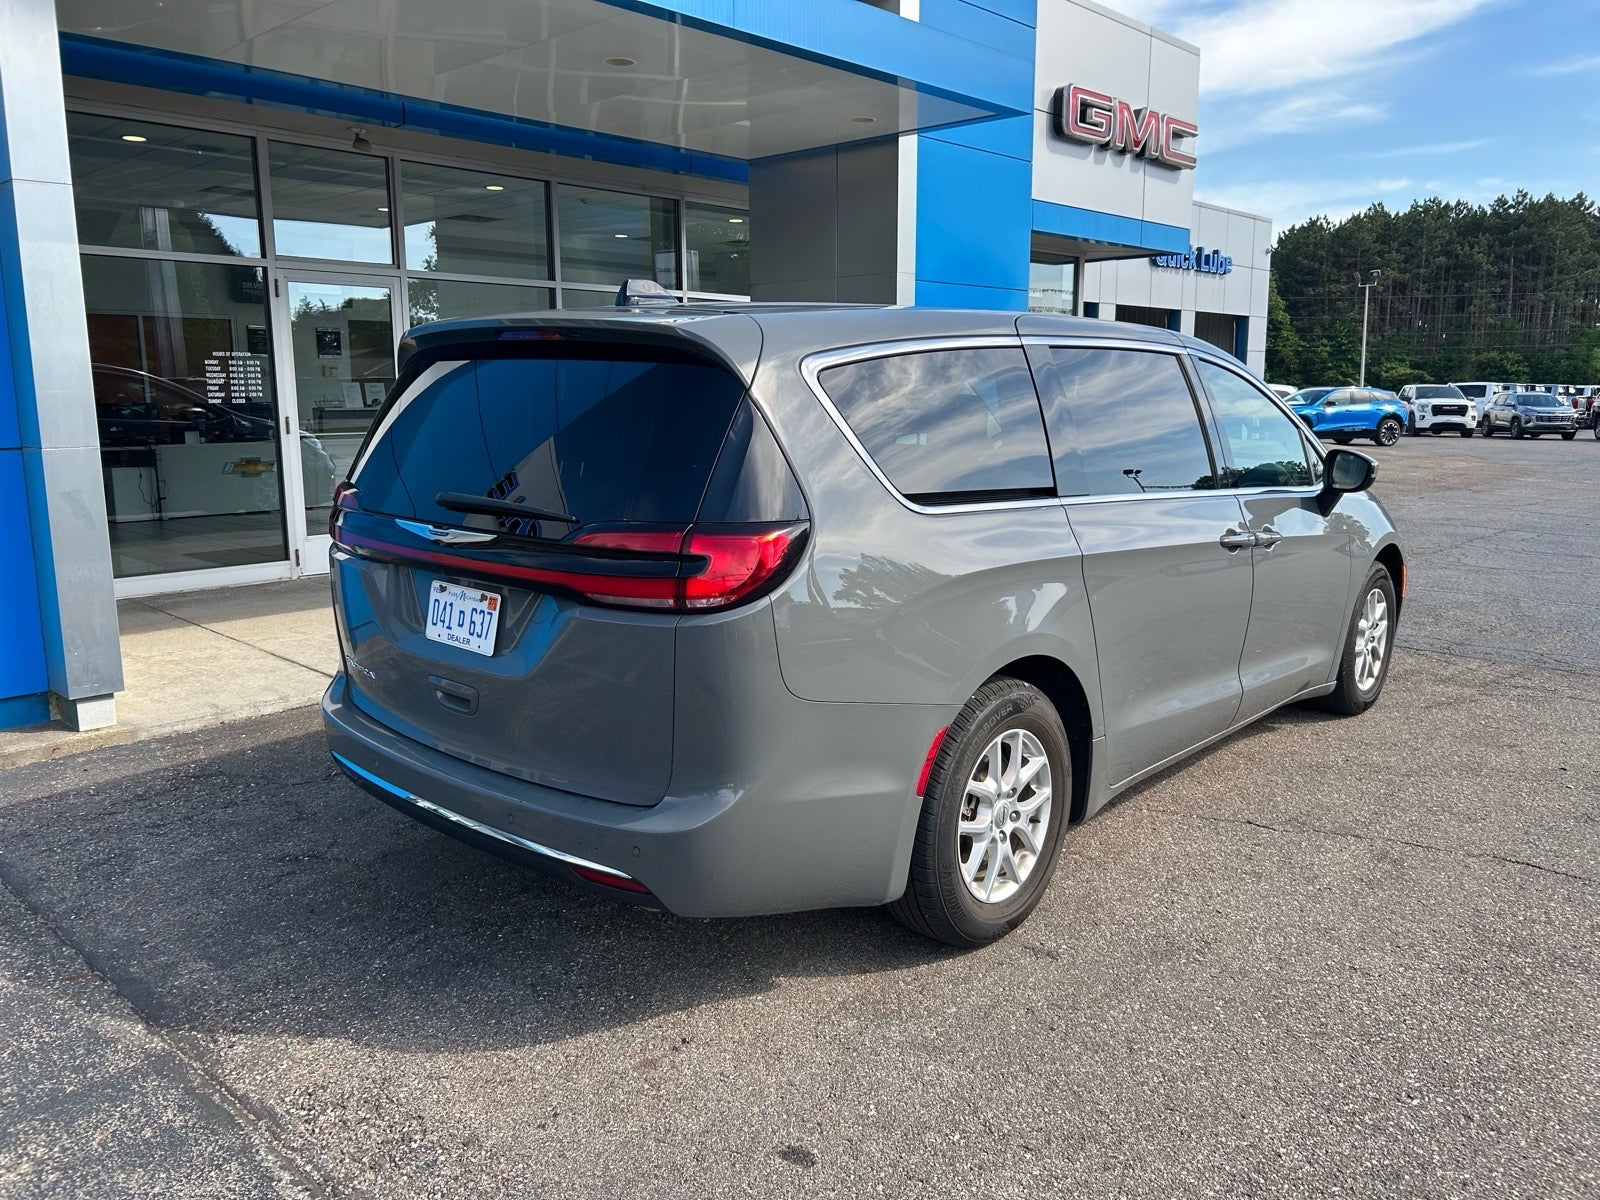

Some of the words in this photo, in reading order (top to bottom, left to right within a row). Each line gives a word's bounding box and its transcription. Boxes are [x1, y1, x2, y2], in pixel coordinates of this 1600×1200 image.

[1056, 83, 1198, 169] GMC
[1200, 246, 1233, 275] Lube
[431, 598, 453, 630] 041
[457, 609, 465, 627] D
[468, 607, 493, 640] 637
[447, 633, 470, 645] DEALER
